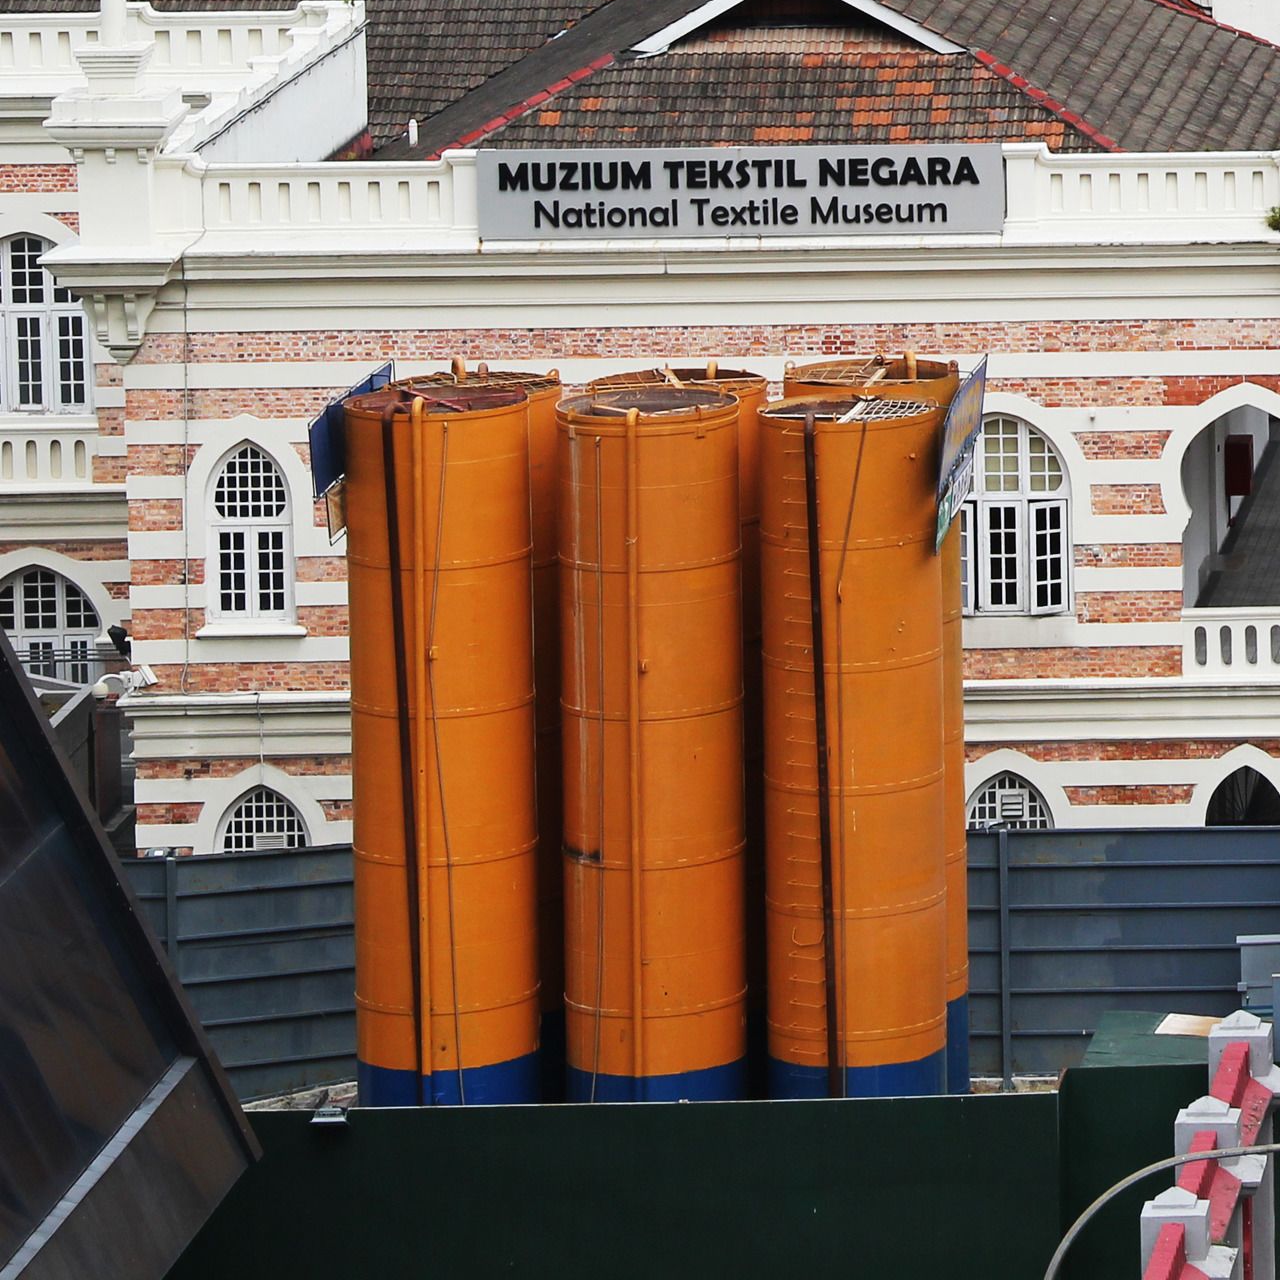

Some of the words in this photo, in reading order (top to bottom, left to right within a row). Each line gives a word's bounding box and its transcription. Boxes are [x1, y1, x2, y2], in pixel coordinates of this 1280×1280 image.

[498, 159, 651, 192] MUZIUM
[663, 158, 807, 190] TEKSTIL
[817, 155, 979, 187] NEGARA
[534, 198, 679, 229] National
[690, 196, 798, 227] Textile
[810, 195, 948, 226] Museum
